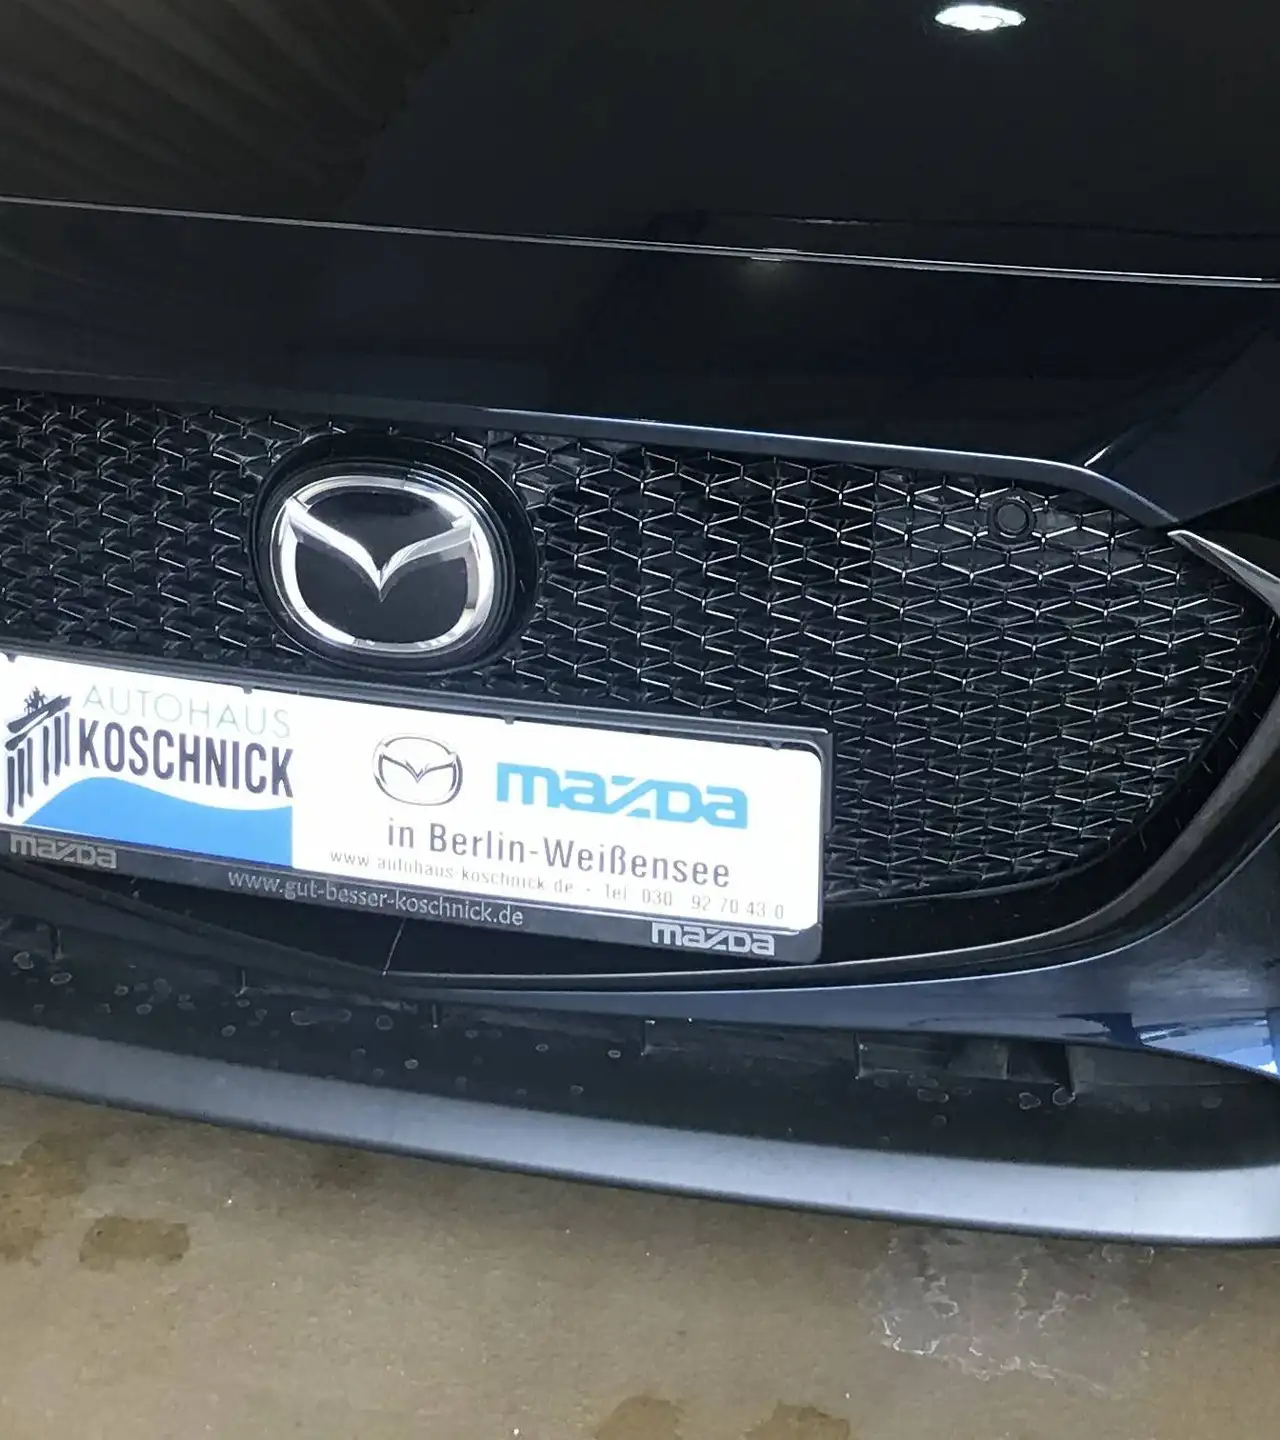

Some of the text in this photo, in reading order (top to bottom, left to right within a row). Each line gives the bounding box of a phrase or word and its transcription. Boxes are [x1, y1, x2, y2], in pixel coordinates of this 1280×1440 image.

[82, 684, 291, 739] AUTOHAUS
[78, 717, 294, 798] KOSCHNICK
[496, 761, 749, 830] mazda
[9, 833, 118, 870] mazda
[329, 850, 573, 893] wwwautohaus-koschnickde
[388, 817, 730, 888] in Berlin-Weißensee
[228, 870, 524, 926] www.gut-besser-koschnick.de
[651, 922, 775, 956] mazda
